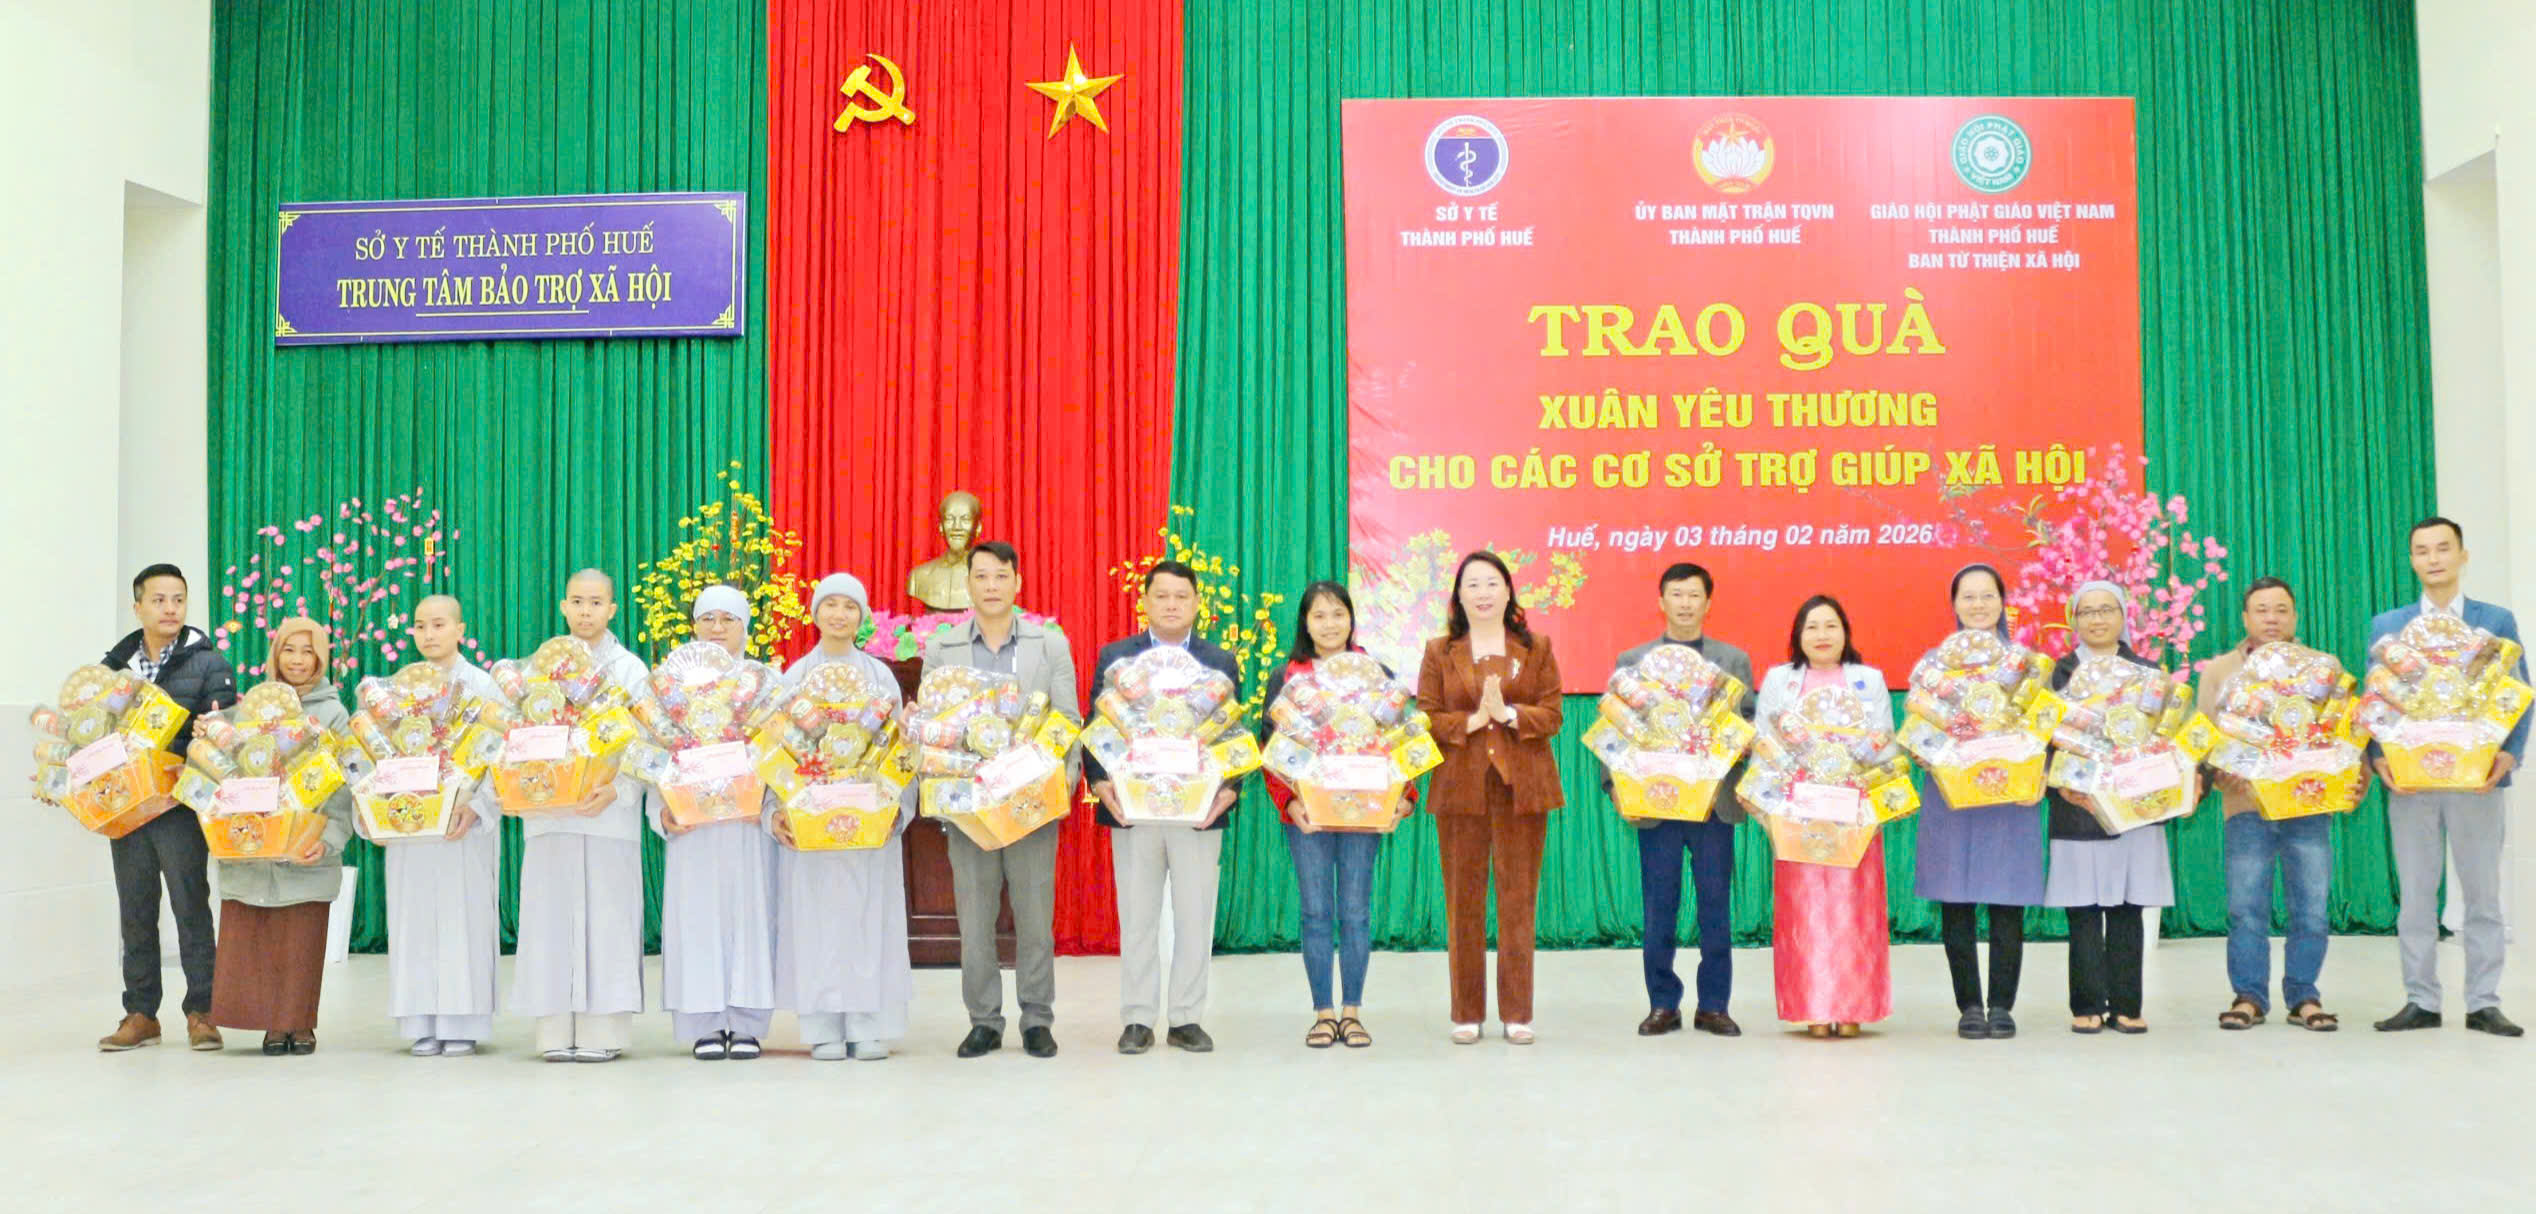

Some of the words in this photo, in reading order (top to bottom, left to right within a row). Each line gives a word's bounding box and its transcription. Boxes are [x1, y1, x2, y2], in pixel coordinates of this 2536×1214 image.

[1436, 201, 1459, 221] SỞ
[1463, 206, 1474, 221] Y
[1478, 201, 1499, 221] TẾ
[1635, 200, 1657, 220] ỦY
[1661, 205, 1697, 220] BAN
[1701, 202, 1738, 223] MẶT
[1743, 201, 1787, 223] TRẬN
[1791, 204, 1834, 220] TQVN
[1870, 202, 1910, 219] GIÁO
[1914, 202, 1942, 223] HỘI
[1947, 202, 1989, 223] PHẬT
[1993, 202, 2033, 219] GIÁO
[2037, 201, 2072, 223] VIỆT
[2075, 204, 2115, 219] NAM
[355, 229, 385, 261] SỞ
[393, 236, 410, 259] Y
[416, 225, 446, 259] TẾ
[454, 228, 538, 257] THÀNH
[545, 221, 596, 256] PHỐ
[603, 221, 655, 255] HUẾ
[1400, 228, 1456, 246] THÀNH
[1461, 226, 1496, 246] PHỐ
[1500, 225, 1535, 246] HUẾ
[1669, 227, 1725, 244] THÀNH
[1729, 224, 1764, 244] PHỐ
[1768, 224, 1802, 244] HUẾ
[1928, 226, 1983, 243] THÀNH
[1988, 224, 2022, 243] PHỐ
[2026, 224, 2059, 243] HUẾ
[1908, 253, 1943, 268] BAN
[1948, 251, 1971, 268] TỪ
[1973, 250, 2020, 272] THIỆN
[2025, 250, 2048, 268] XÃ
[2052, 250, 2080, 272] HỘI
[337, 276, 417, 309] TRUNG
[422, 268, 473, 307] TÂM
[479, 263, 528, 306] BẢO
[534, 268, 584, 311] TRỢ
[588, 265, 620, 304] XÃ
[627, 263, 672, 309] HỘI
[1527, 302, 1746, 357] TRAO
[1777, 287, 1947, 371] QUÀ
[1539, 387, 1658, 429] XUÂN
[1672, 386, 1753, 428] YÊU
[1766, 389, 1937, 427] THƯƠNG
[1389, 455, 1475, 489] CHO
[1490, 447, 1577, 489] CÁC
[1592, 450, 1651, 489] CƠ
[1664, 442, 1723, 488] SỞ
[1735, 449, 1818, 494] TRỢ
[1831, 444, 1930, 486] GIÚP
[1945, 444, 2003, 486] XÃ
[2016, 443, 2086, 491] HỘI
[1548, 524, 1600, 551] Huế,
[1609, 527, 1668, 552] ngày
[1675, 526, 1702, 547] 03
[1710, 525, 1778, 552] tháng
[1785, 525, 1813, 545] 02
[1820, 525, 1871, 546] năm
[1878, 524, 1934, 544] 2026
